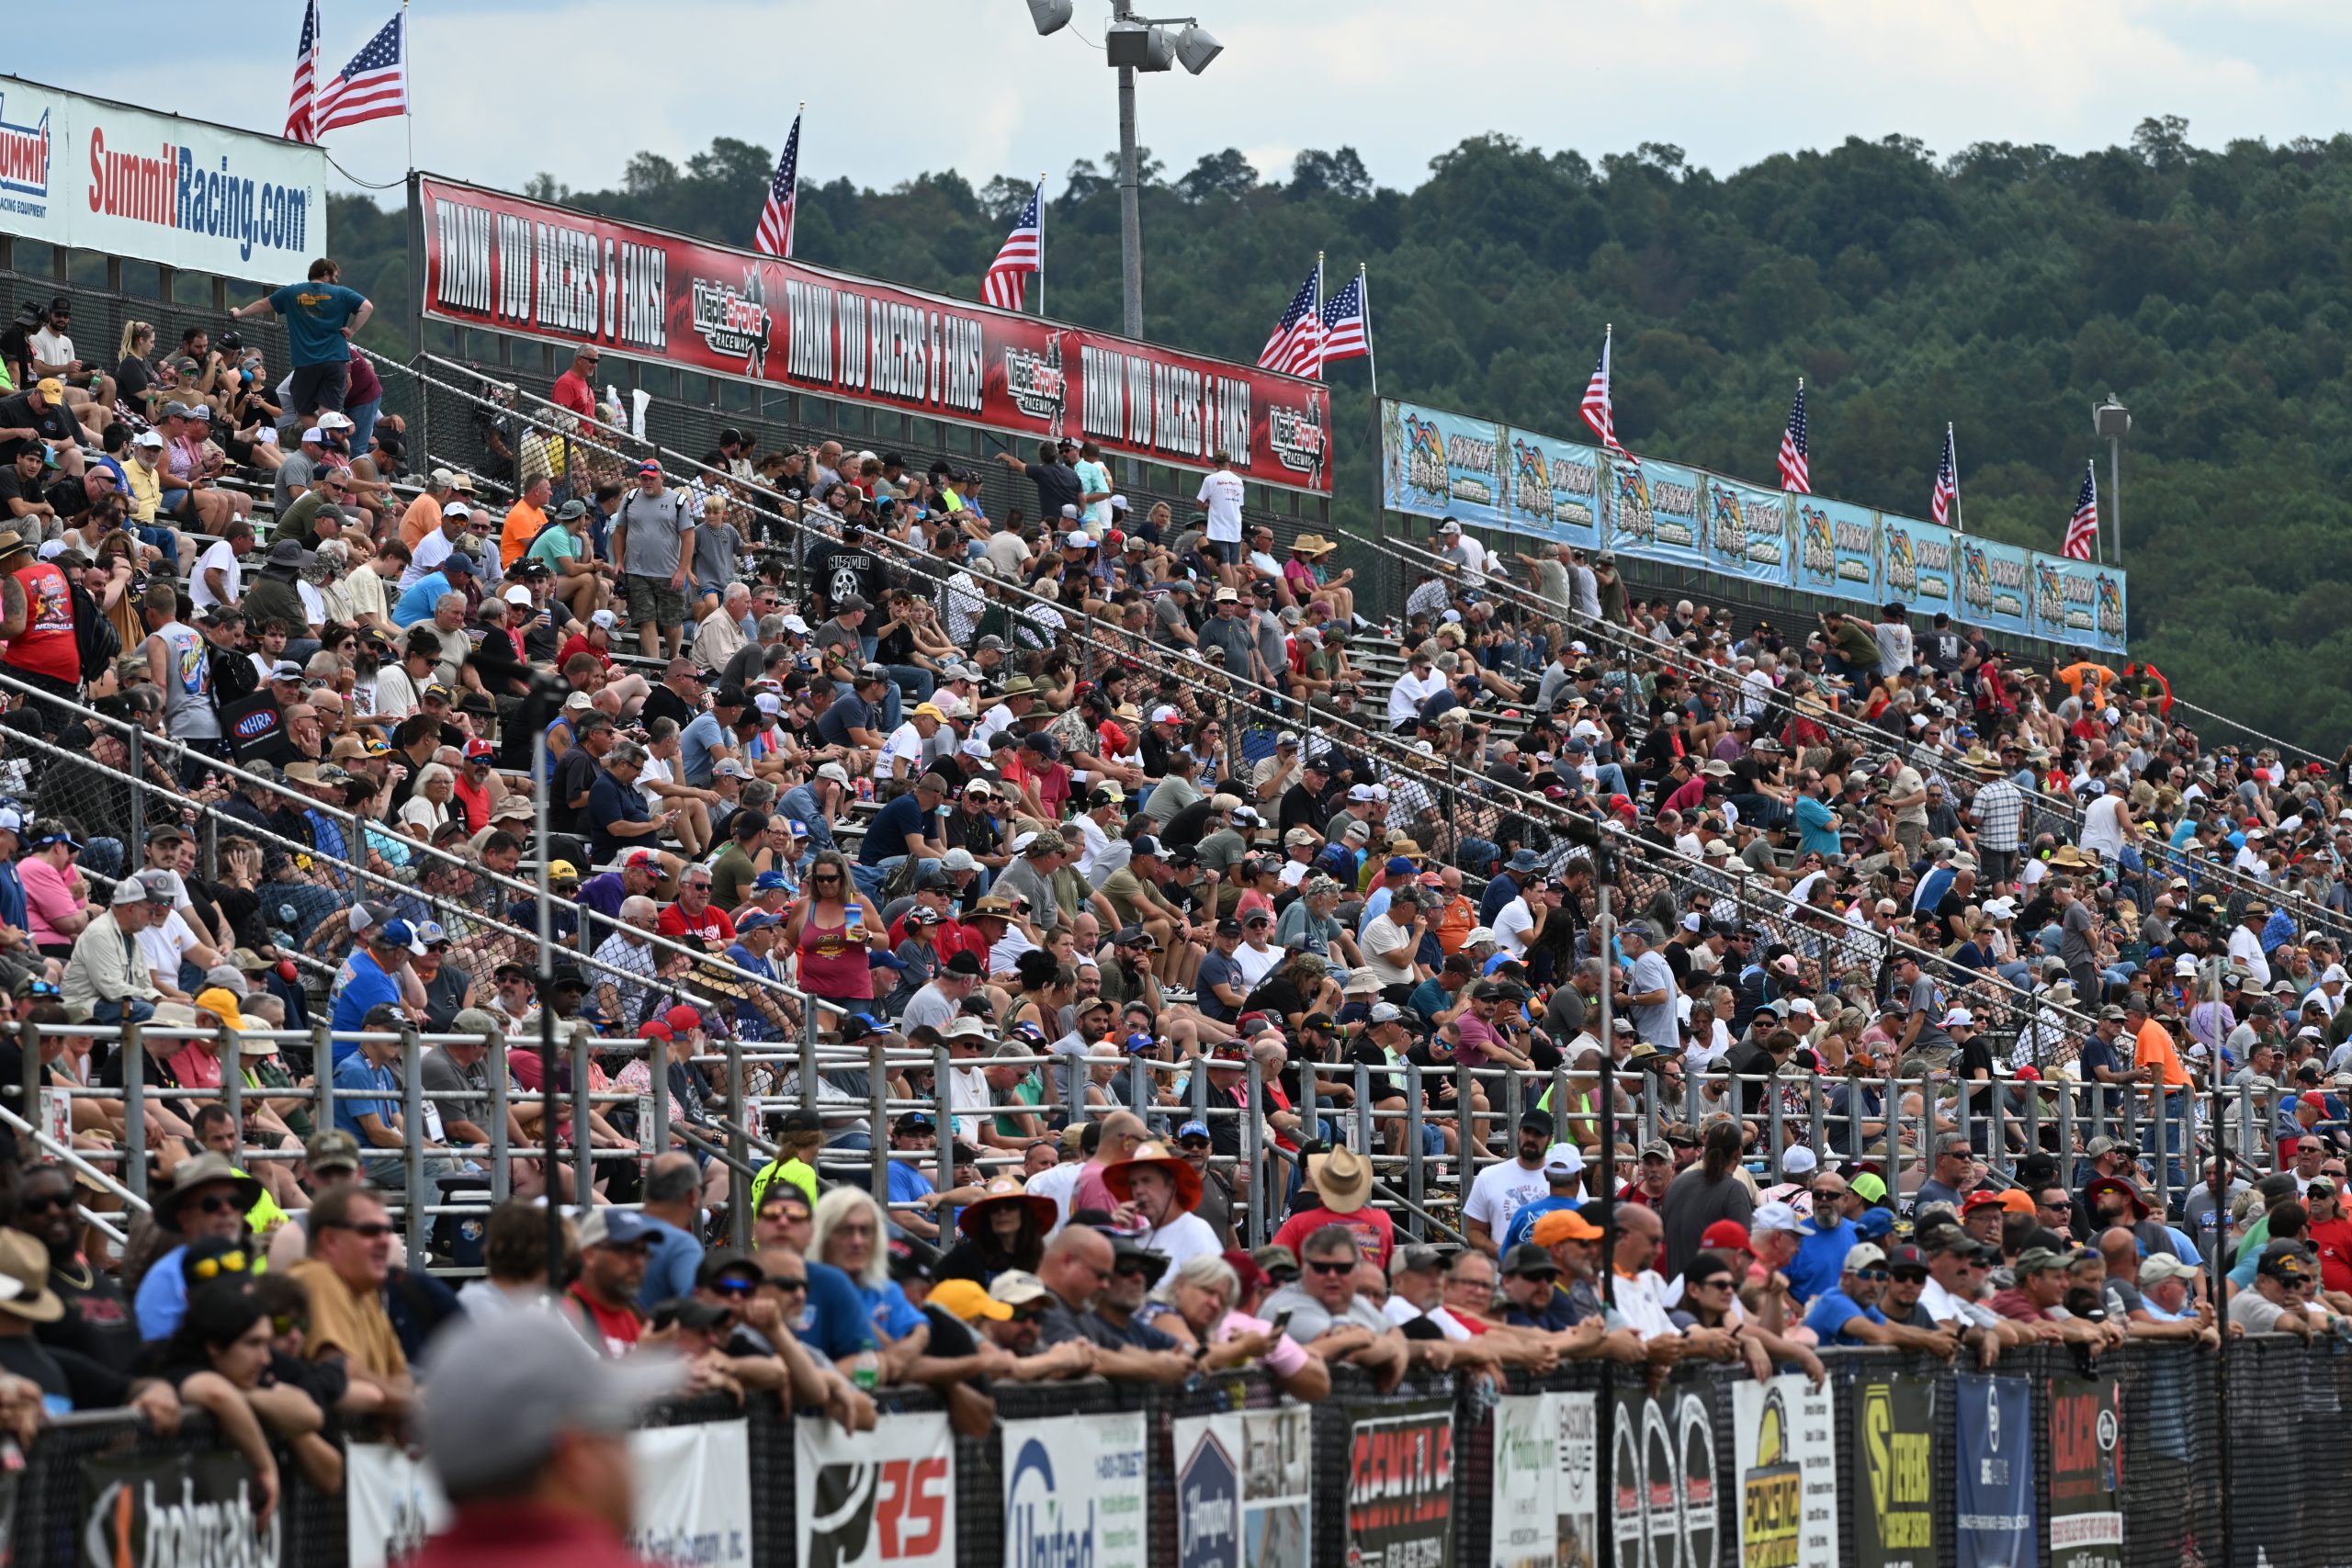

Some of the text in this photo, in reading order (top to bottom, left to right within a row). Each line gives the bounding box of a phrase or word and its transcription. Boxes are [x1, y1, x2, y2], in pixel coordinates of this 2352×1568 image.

[0, 197, 47, 219] ACING EQUIPMENT
[435, 197, 667, 351] THANK YOU RACERS & FANS!
[715, 331, 751, 352] RACEWAY
[786, 278, 983, 415] THANK YOU RACERS & FANS!
[1024, 396, 1052, 413] RACEWAY
[1080, 344, 1251, 470] THANK YOU RACERS & FANS!
[1286, 450, 1312, 466] RACEWAY
[829, 555, 870, 570] NISMO
[239, 713, 272, 735] NHRA
[1016, 1499, 1094, 1568] United
